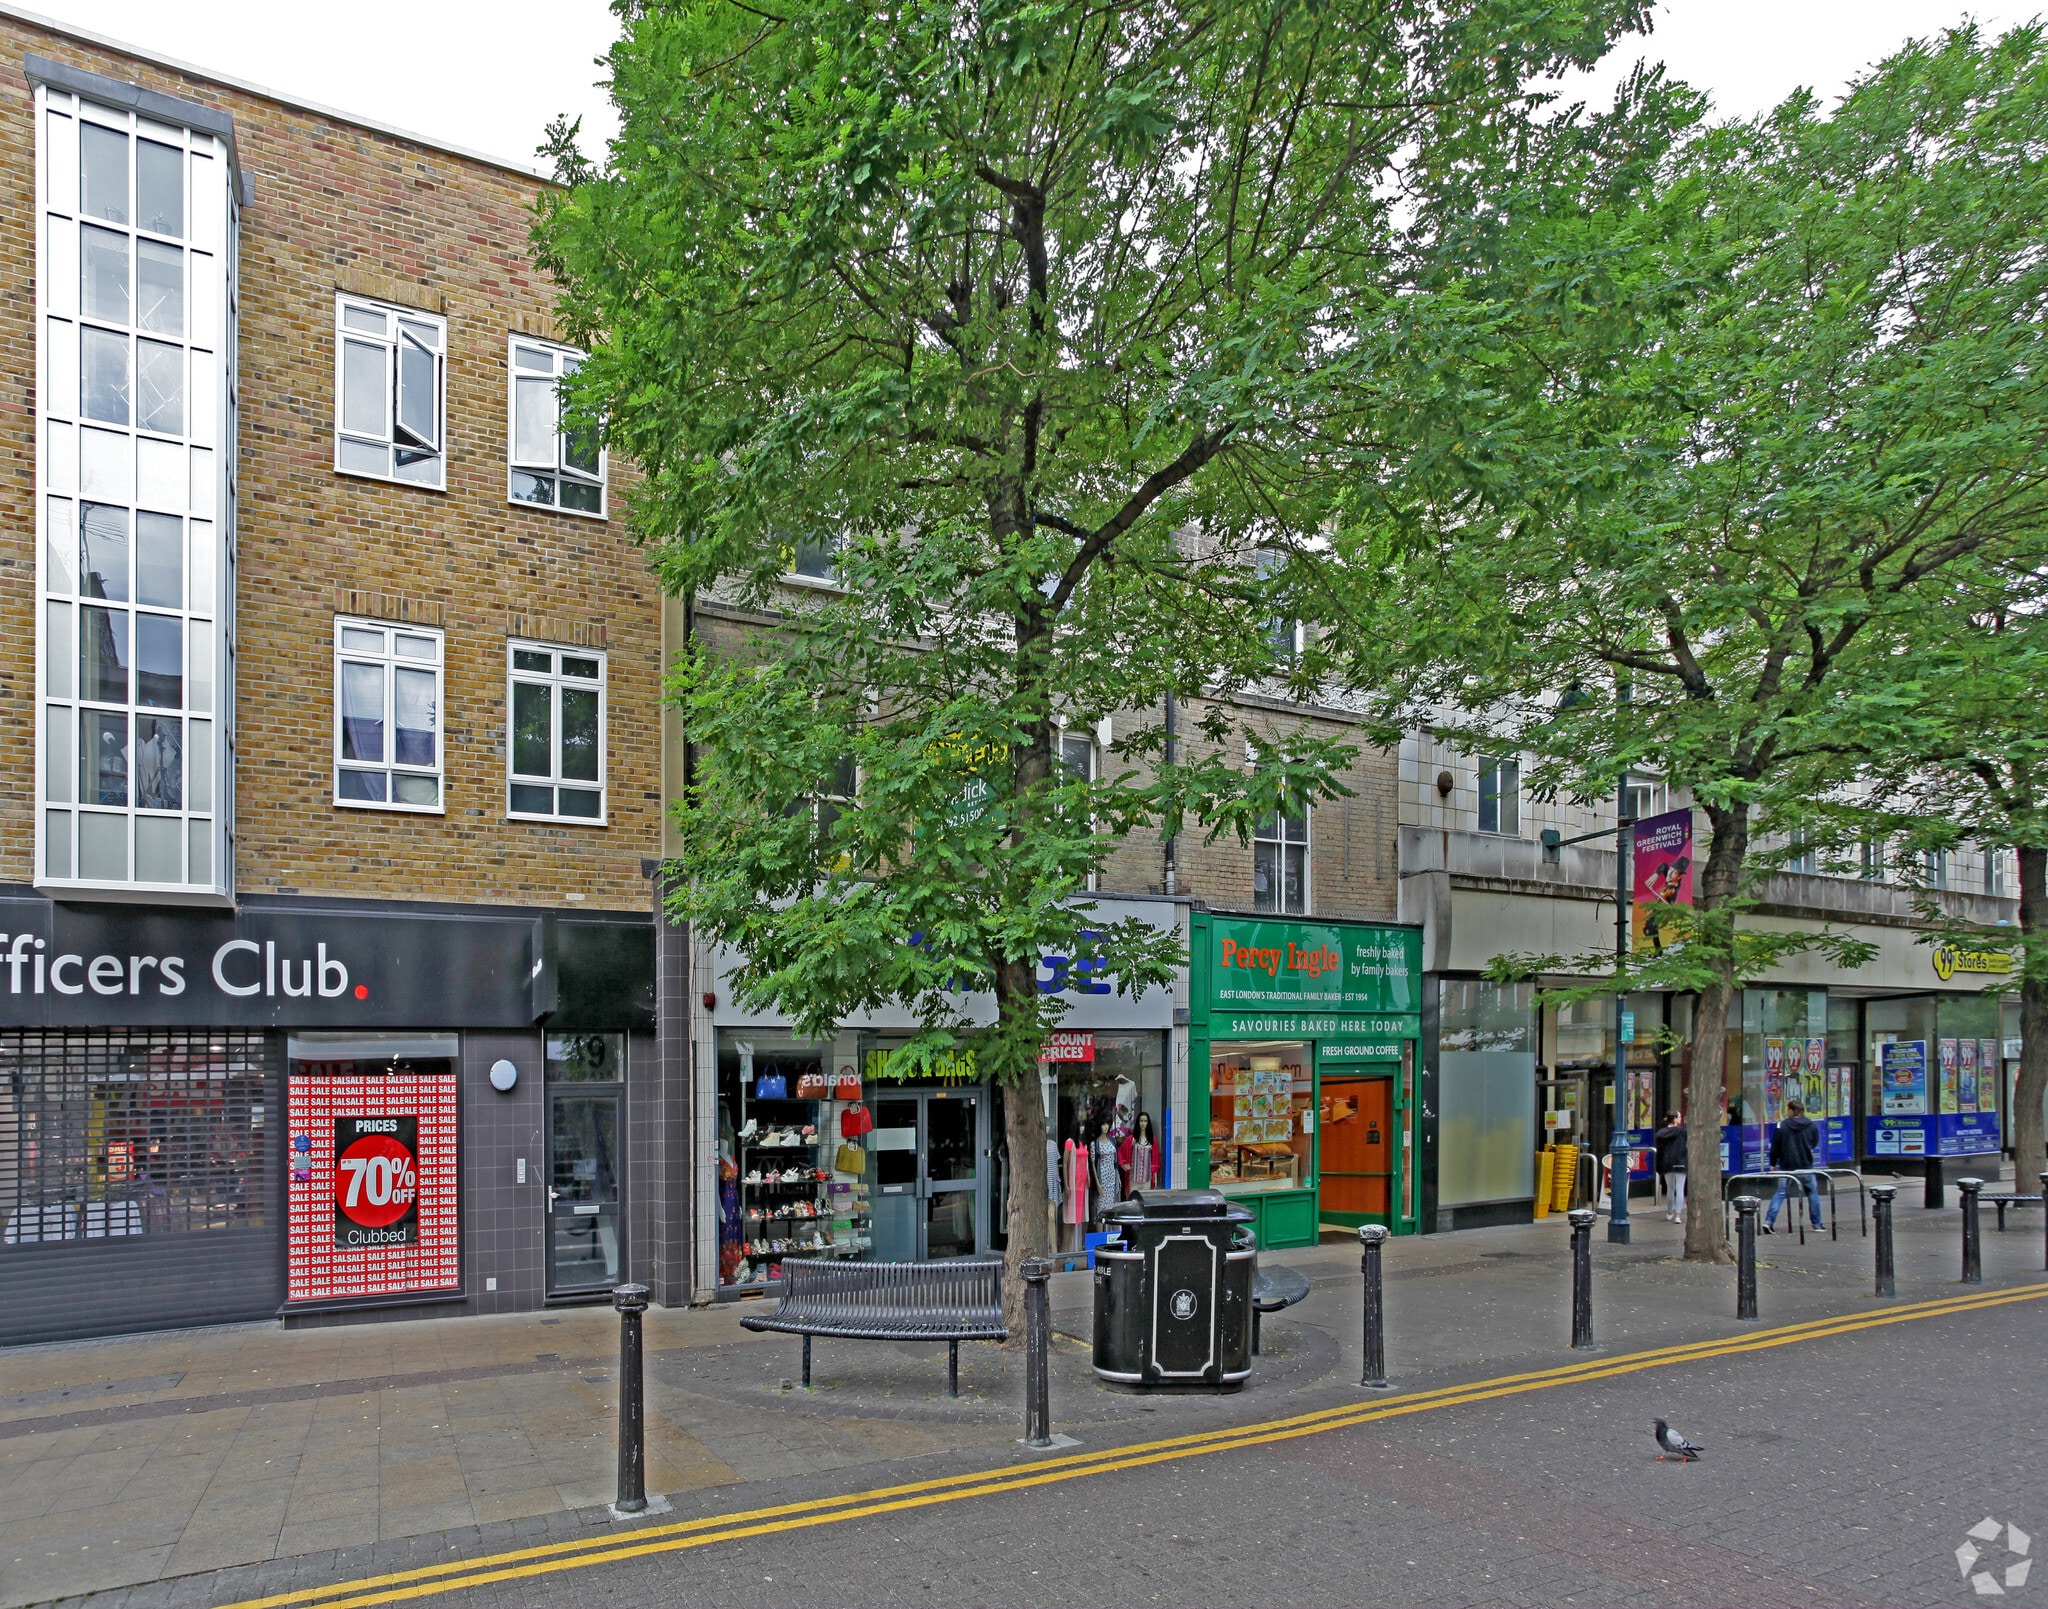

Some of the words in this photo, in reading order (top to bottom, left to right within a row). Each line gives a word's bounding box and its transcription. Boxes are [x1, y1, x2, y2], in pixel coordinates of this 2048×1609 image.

[1656, 824, 1682, 835] ROYAL
[1636, 831, 1682, 848] GREENWICH
[1642, 838, 1682, 853] FESTIVALS
[1356, 945, 1381, 959] freshly
[1382, 947, 1404, 959] baked
[1220, 939, 1282, 976] Percy
[1288, 942, 1339, 978] Ingle
[1958, 952, 1986, 968] Stores
[0, 933, 186, 995] ficers
[1352, 963, 1360, 977] by
[1362, 964, 1384, 978] family
[1385, 965, 1408, 976] bakers
[1220, 990, 1235, 999] EAST
[1236, 990, 1264, 999] LONDON'S
[1266, 991, 1302, 1000] TRADITIONAL
[1304, 992, 1323, 1000] FAMILY
[1324, 992, 1342, 1000] BAKER
[1232, 1020, 1296, 1031] SAVOURIES
[1301, 1020, 1336, 1031] BAKED
[1341, 1021, 1366, 1031] HERE
[1371, 1021, 1404, 1032] TODAY
[1040, 1033, 1093, 1046] COUNT
[1041, 1046, 1084, 1059] PRICES
[1322, 1046, 1343, 1056] FRESH
[1344, 1046, 1374, 1056] GROUND
[1375, 1045, 1398, 1055] COFFEE
[290, 1076, 309, 1085] SALE
[311, 1076, 330, 1085] SALE
[366, 1076, 384, 1085] SALE
[419, 1076, 437, 1084] SALE
[290, 1088, 309, 1096] SALE
[366, 1086, 384, 1095] SALE
[419, 1086, 437, 1094] SALE
[439, 1086, 456, 1094] SALE
[290, 1098, 309, 1106] SALE
[311, 1098, 330, 1106] SALE
[439, 1096, 456, 1104] SALE
[290, 1108, 309, 1117] SALE
[311, 1108, 330, 1117] SALE
[366, 1108, 384, 1116] SALE
[439, 1106, 456, 1114] SALE
[290, 1120, 309, 1128] SALE
[311, 1118, 330, 1127] SALE
[420, 1116, 437, 1125] SALE
[439, 1116, 456, 1124] SALE
[356, 1120, 397, 1132] PRICES
[420, 1126, 437, 1135] SALE
[311, 1130, 330, 1138] SALE
[420, 1136, 437, 1145] SALE
[311, 1150, 330, 1159] SALE
[439, 1146, 456, 1155] SALE
[439, 1156, 456, 1165] SALE
[439, 1166, 457, 1175] SALE
[311, 1172, 330, 1180] SALE
[420, 1178, 437, 1186] SALE
[439, 1176, 457, 1185] SALE
[340, 1156, 416, 1207] 70%
[420, 1188, 438, 1196] SALE
[440, 1186, 457, 1195] SALE
[290, 1194, 309, 1202] SALE
[311, 1192, 330, 1201] SALE
[392, 1189, 415, 1204] OFF
[290, 1204, 309, 1213] SALE
[312, 1204, 330, 1212] SALE
[290, 1226, 309, 1234] SALE
[312, 1224, 330, 1233] SALE
[290, 1236, 309, 1245] SALE
[348, 1228, 406, 1244] Clubbed
[420, 1238, 438, 1247] SALE
[312, 1246, 330, 1254] SALE
[290, 1258, 309, 1266] SALE
[367, 1252, 385, 1261] SALE
[421, 1248, 438, 1257] SALE
[440, 1248, 457, 1256] SALE
[290, 1268, 309, 1277] SALE
[312, 1266, 330, 1275] SALE
[440, 1258, 457, 1266] SALE
[290, 1278, 310, 1287] SALE
[367, 1274, 385, 1282] SALE
[440, 1268, 457, 1276] SALE
[290, 1290, 310, 1298] SALE
[312, 1288, 330, 1297] SALE
[368, 1284, 385, 1293] SALE
